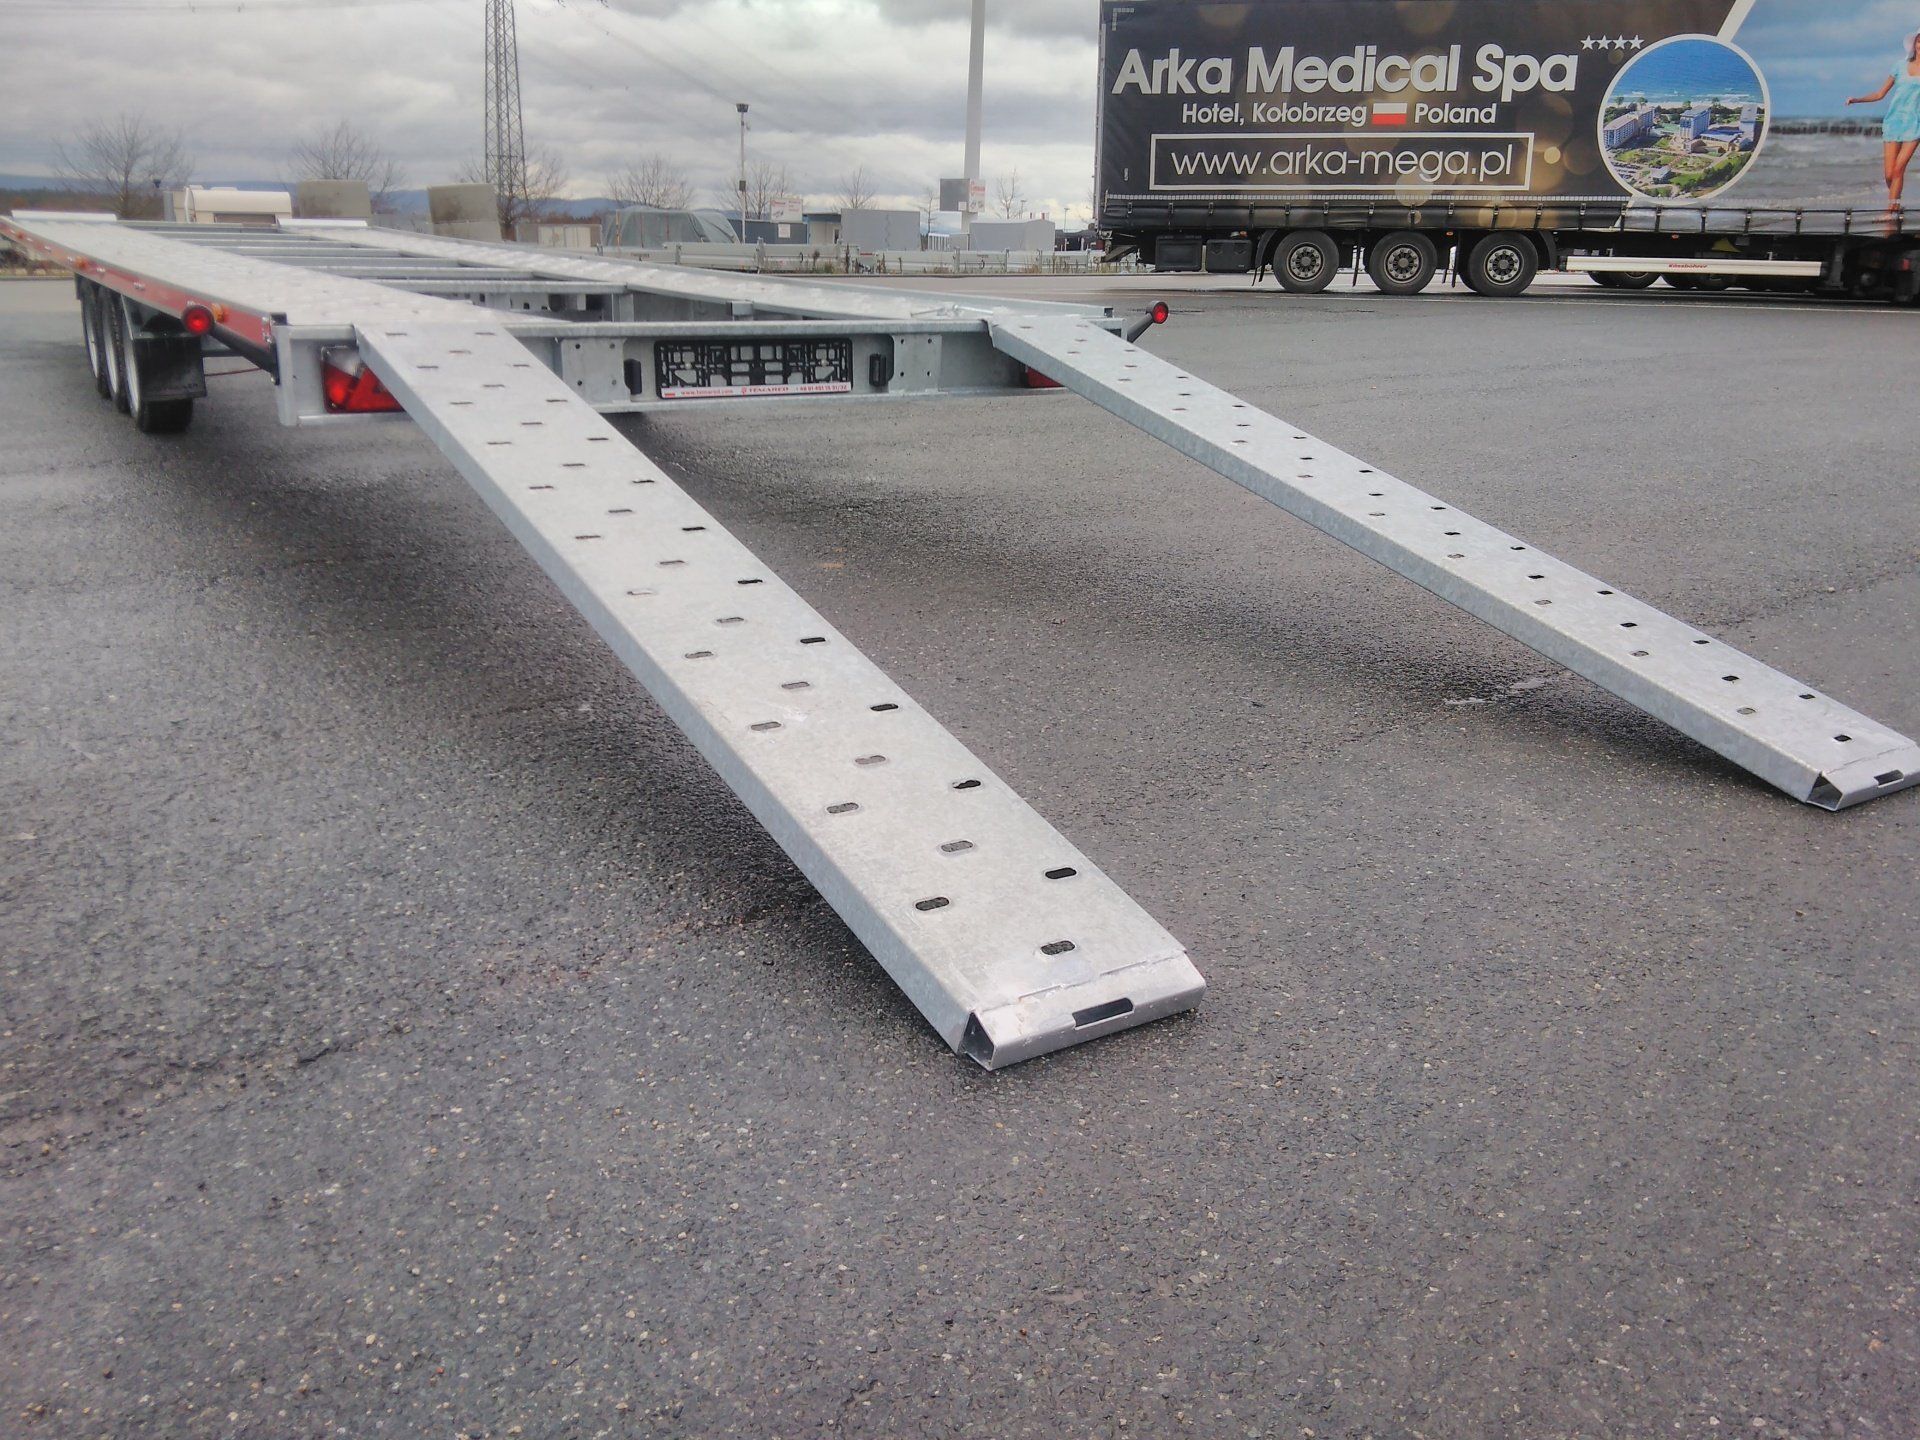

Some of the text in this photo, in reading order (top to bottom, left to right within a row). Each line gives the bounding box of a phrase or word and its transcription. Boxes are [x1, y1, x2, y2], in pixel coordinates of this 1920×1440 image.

[1111, 43, 1579, 103] Arka Medical Spa
[1182, 101, 1497, 128] Hotel, Kołobrzeg Poland
[1170, 143, 1513, 183] www.arka-mega.pl
